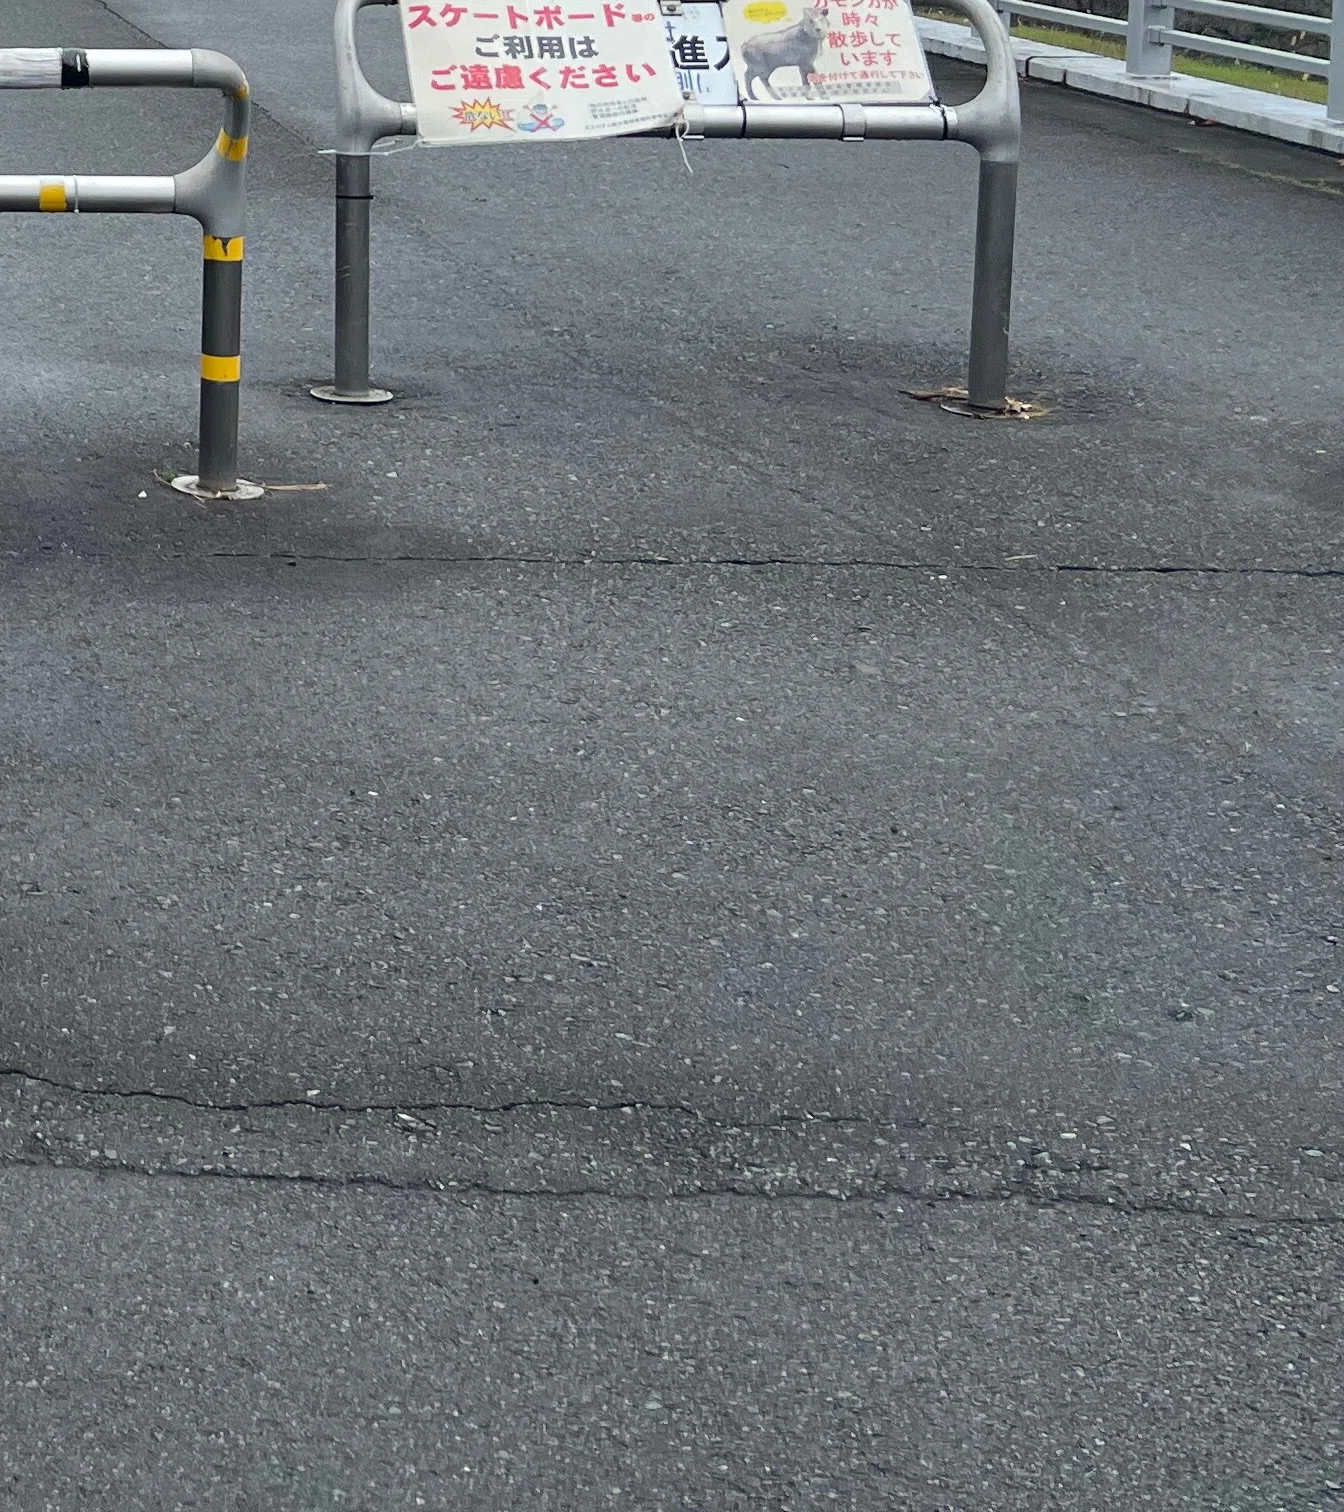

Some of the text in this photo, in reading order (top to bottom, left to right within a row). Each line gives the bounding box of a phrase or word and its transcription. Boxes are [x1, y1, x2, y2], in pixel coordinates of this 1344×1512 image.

[842, 12, 879, 28] 時々
[475, 35, 599, 59] ご利用は
[827, 30, 902, 48] 散歩して
[840, 51, 897, 66] います
[431, 63, 656, 90] ご遠慮ください
